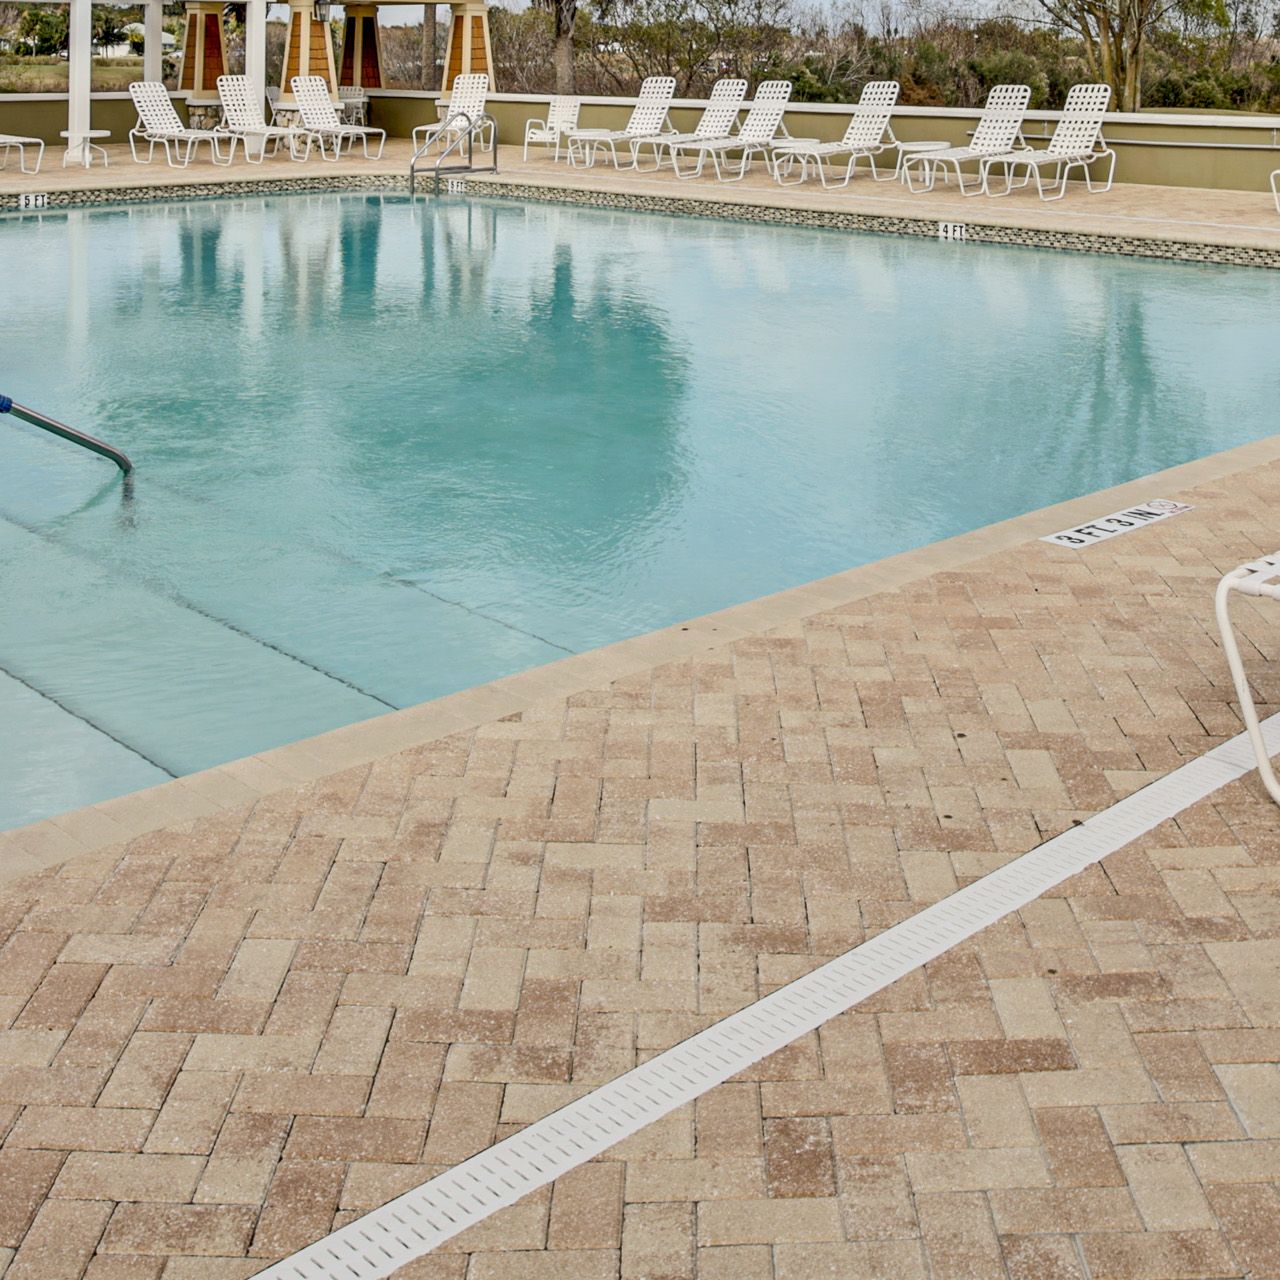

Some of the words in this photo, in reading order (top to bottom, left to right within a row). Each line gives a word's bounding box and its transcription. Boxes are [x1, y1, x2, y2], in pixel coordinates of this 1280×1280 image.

[24, 195, 30, 206] 5
[34, 194, 45, 207] FT
[942, 224, 948, 236] 4
[952, 225, 963, 236] FT
[1055, 535, 1086, 544] 3
[1105, 518, 1135, 527] 3
